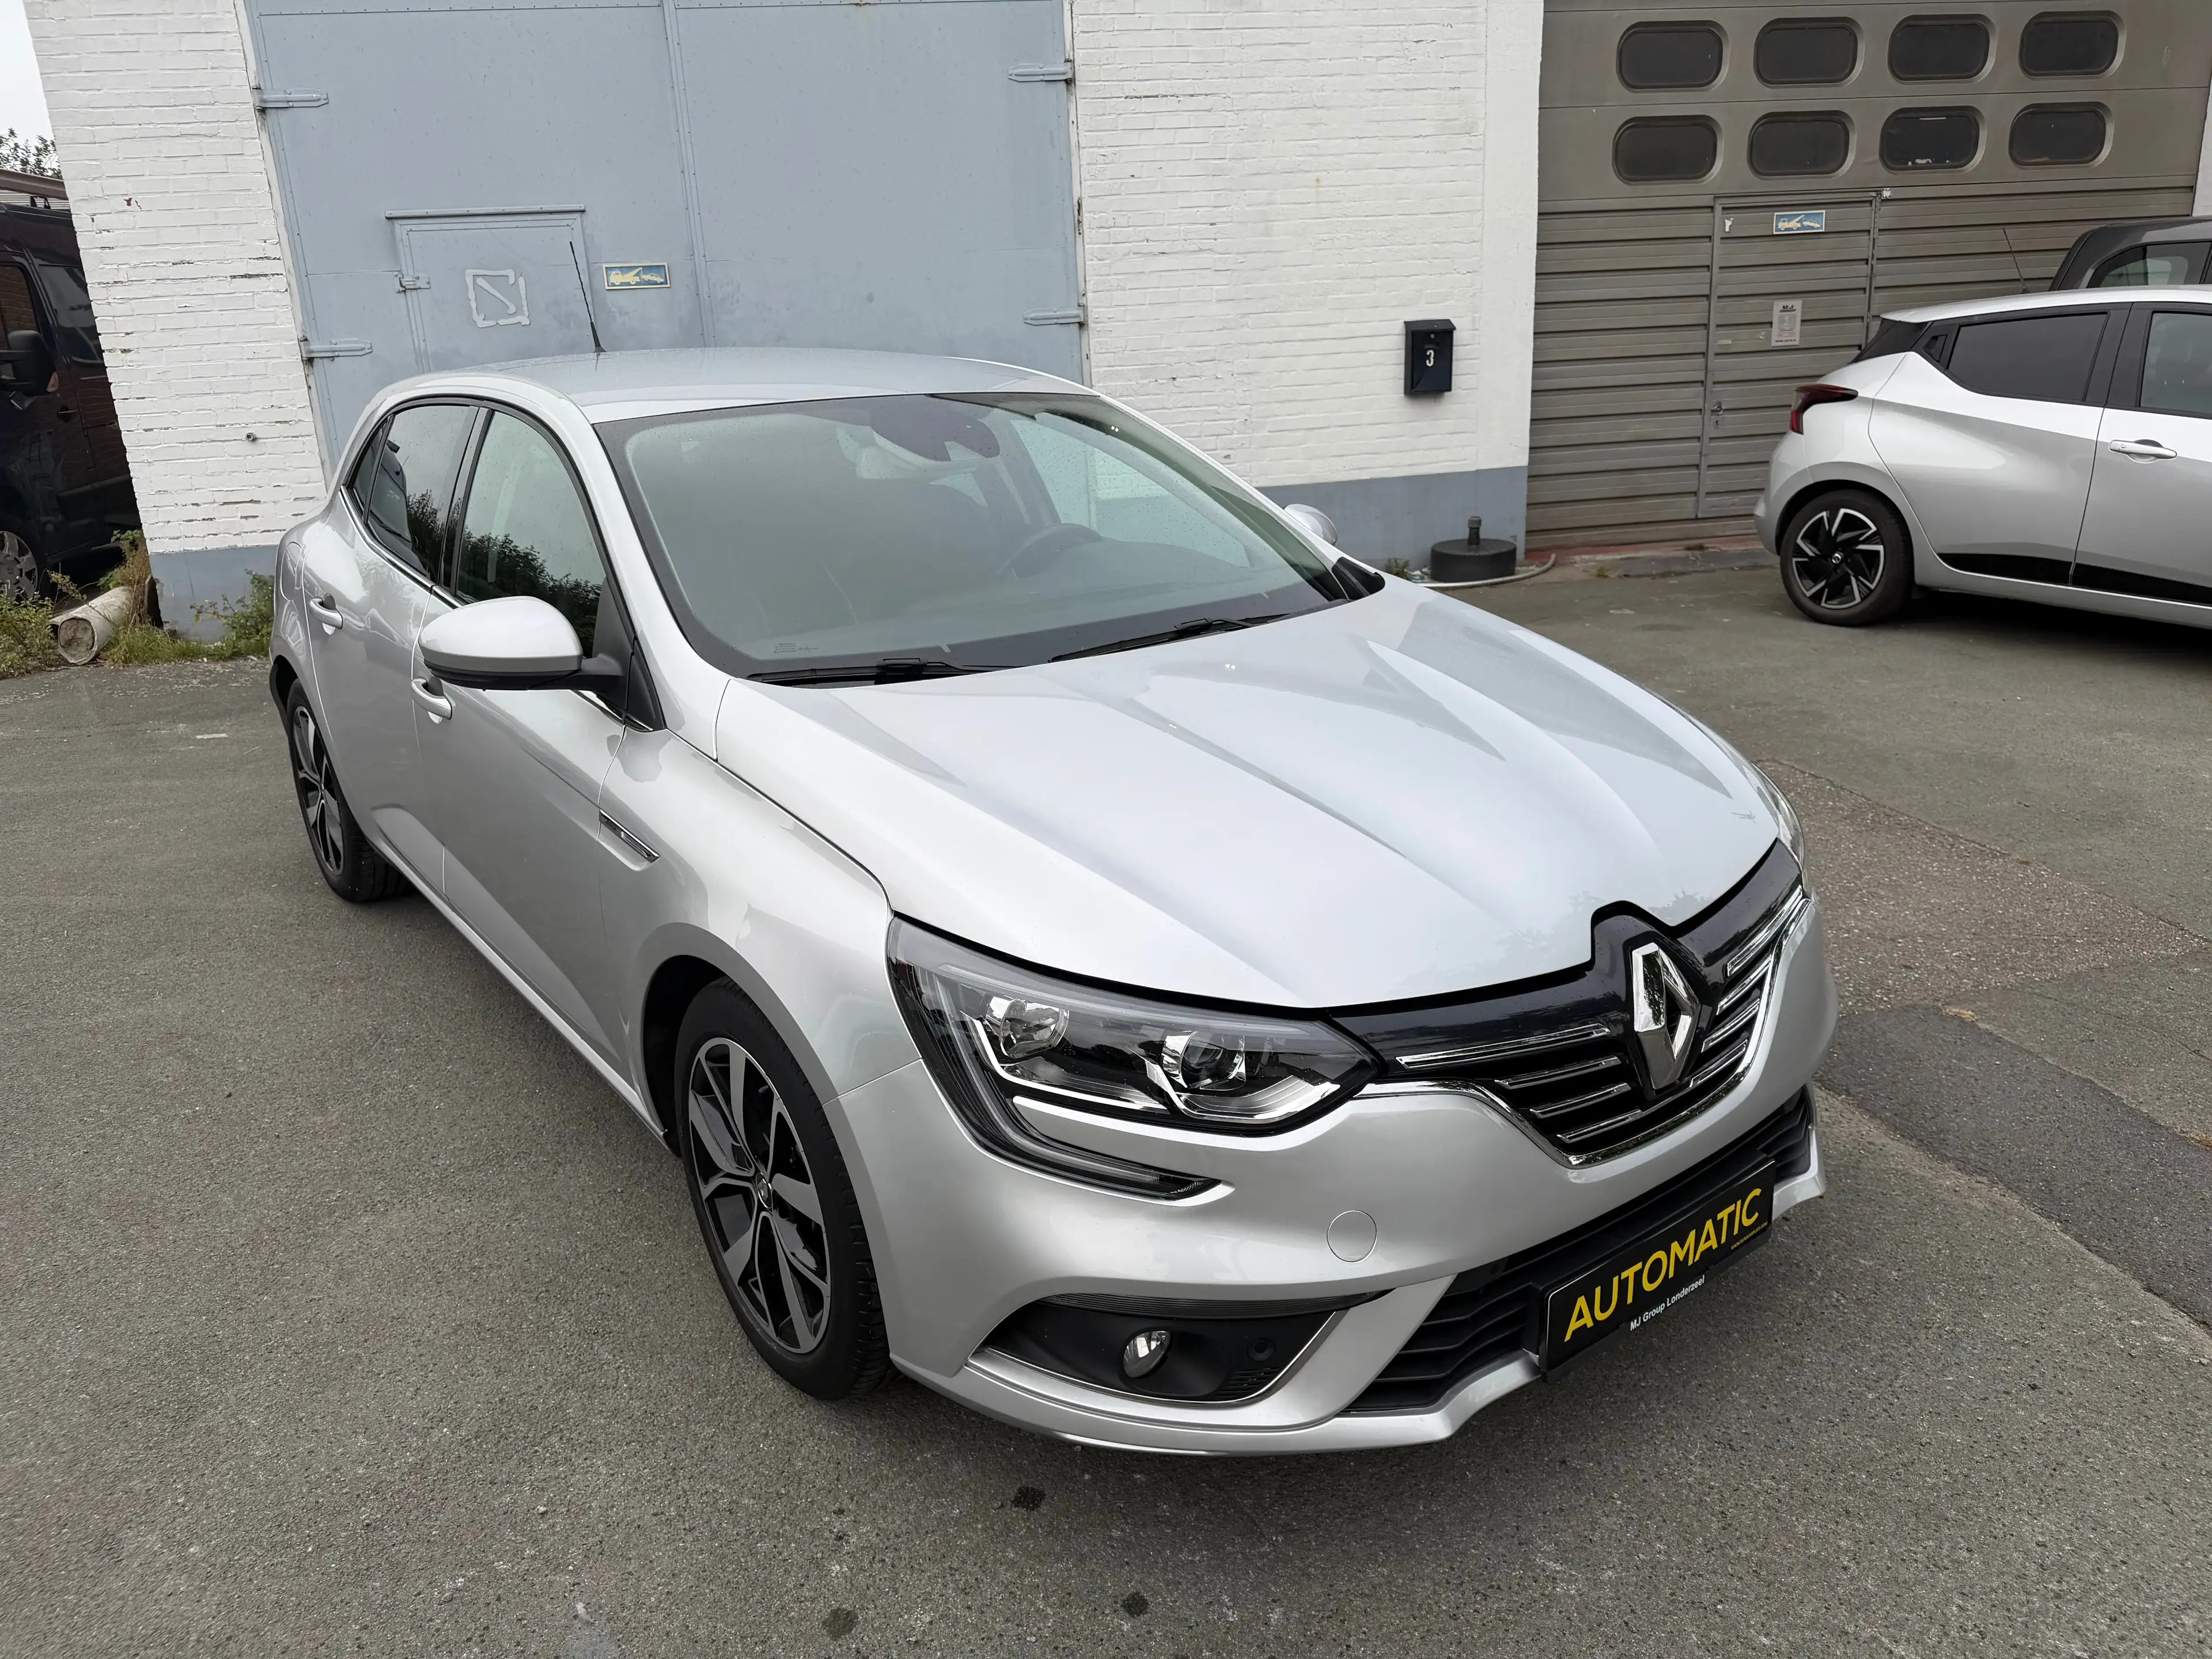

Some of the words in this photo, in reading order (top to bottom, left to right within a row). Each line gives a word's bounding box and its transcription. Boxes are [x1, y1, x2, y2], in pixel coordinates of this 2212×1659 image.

[1426, 350, 1434, 367] 3
[1564, 1188, 1762, 1342] AUTOMATIC
[1630, 1316, 1641, 1331] MJ
[1643, 1303, 1665, 1322] Group
[1666, 1275, 1705, 1306] Londerzeel
